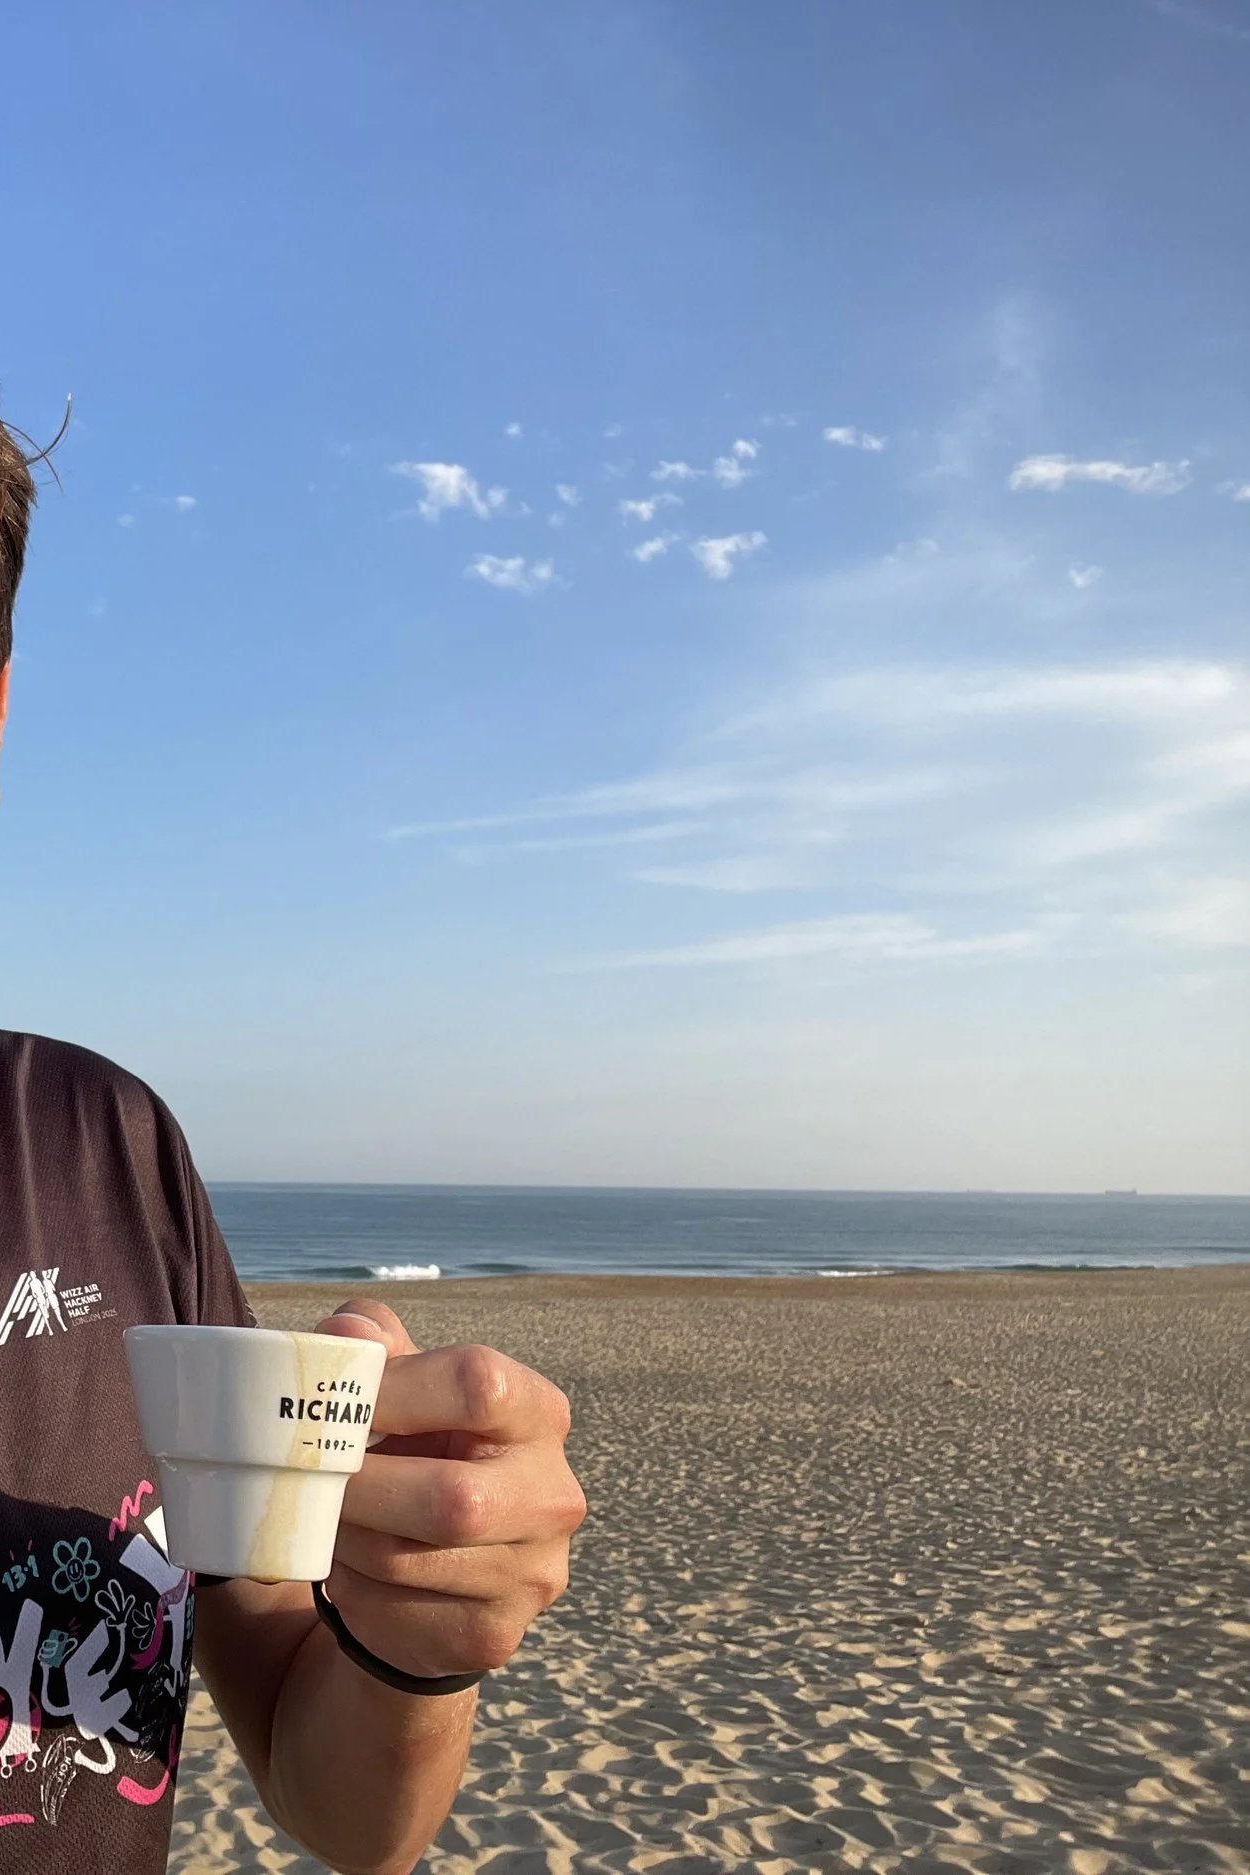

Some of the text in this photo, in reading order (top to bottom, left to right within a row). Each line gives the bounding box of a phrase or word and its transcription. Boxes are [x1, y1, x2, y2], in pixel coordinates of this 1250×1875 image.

[59, 1284, 99, 1300] WIZZ AIR
[64, 1293, 102, 1309] HACKNEY
[67, 1305, 90, 1318] HALF
[71, 1312, 102, 1326] LONDON
[317, 1380, 362, 1395] CAFÉS
[279, 1397, 372, 1425] RICHARD
